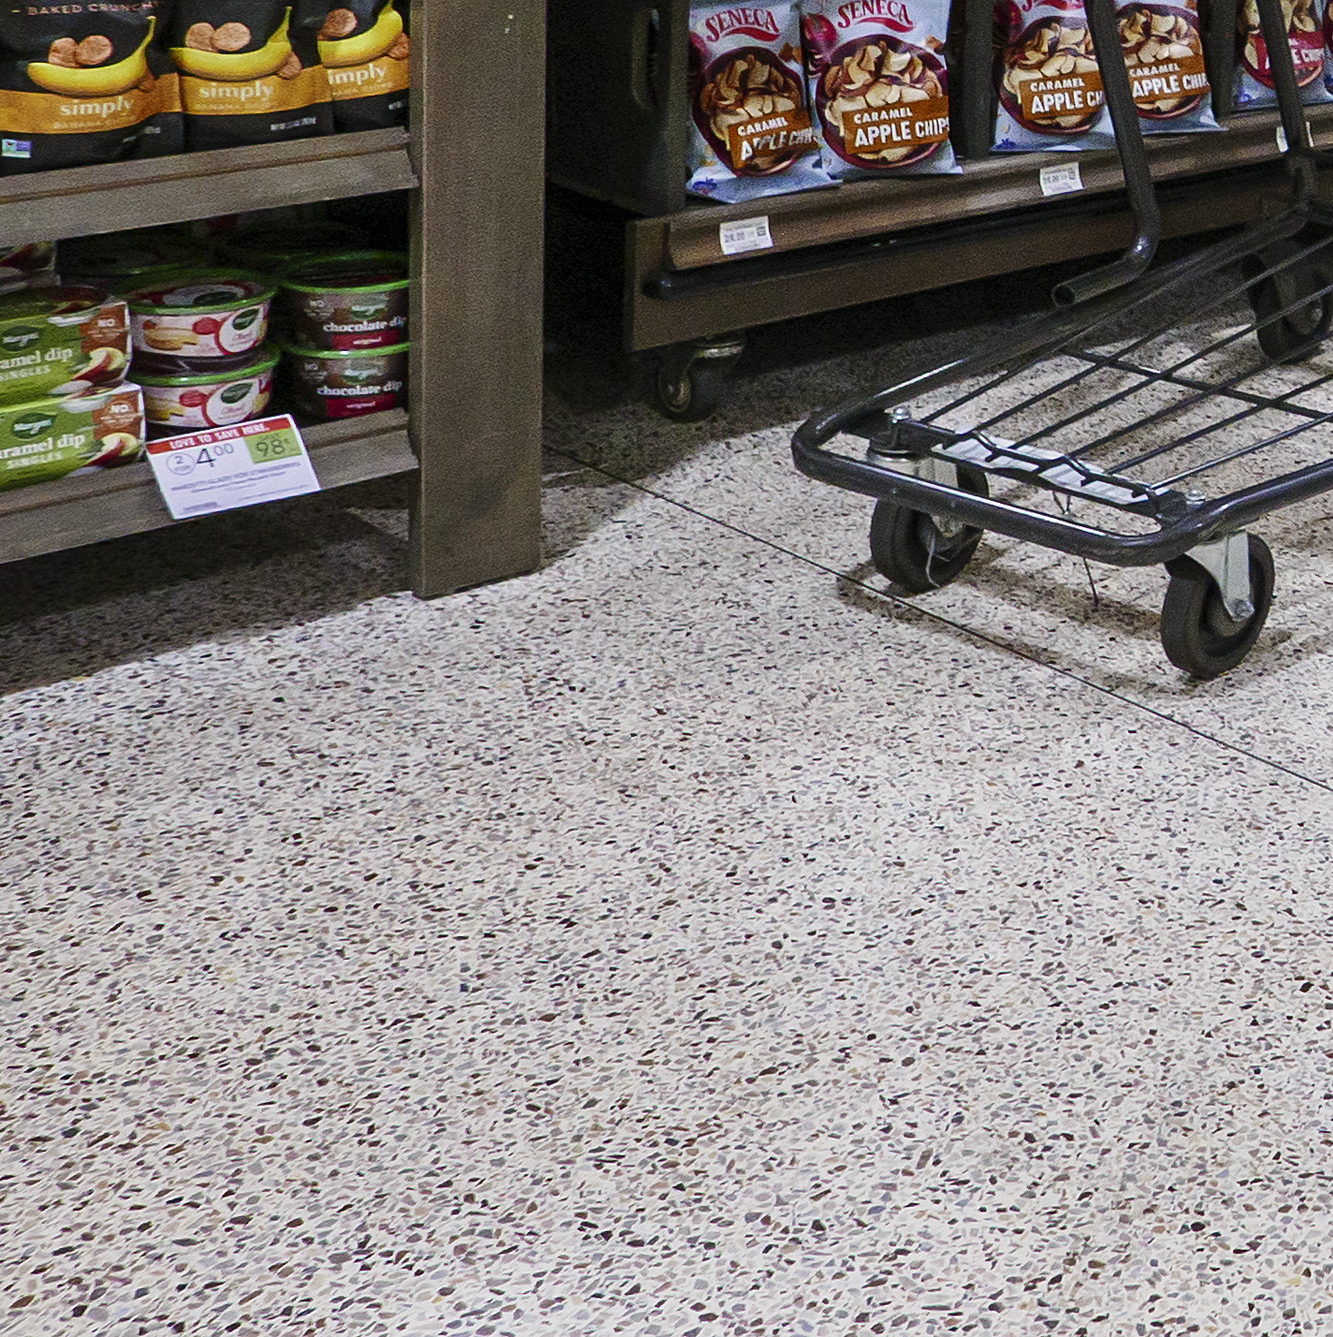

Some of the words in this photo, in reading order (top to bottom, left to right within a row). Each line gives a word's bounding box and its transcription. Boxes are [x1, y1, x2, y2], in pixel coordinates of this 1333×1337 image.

[28, 4, 83, 16] BAKED
[705, 7, 780, 43] SENECA
[328, 63, 387, 87] imply
[1129, 63, 1181, 78] CARAMEL
[199, 82, 274, 102] simply
[1030, 77, 1086, 93] CARAMEL
[1132, 74, 1181, 99] APPLE
[60, 95, 133, 118] simply
[1031, 89, 1084, 114] APPLE
[853, 106, 913, 125] CARAMEL
[737, 115, 789, 137] CARAMEL
[854, 120, 912, 148] APPLE
[323, 319, 388, 333] chocolate
[0, 349, 41, 369] amel
[44, 346, 73, 363] dip
[316, 383, 381, 396] chocolate
[57, 434, 86, 452] dip
[169, 437, 197, 450] LOVE
[199, 434, 212, 444] TO
[214, 429, 240, 442] SAVE
[6, 450, 64, 470] SINGLES
